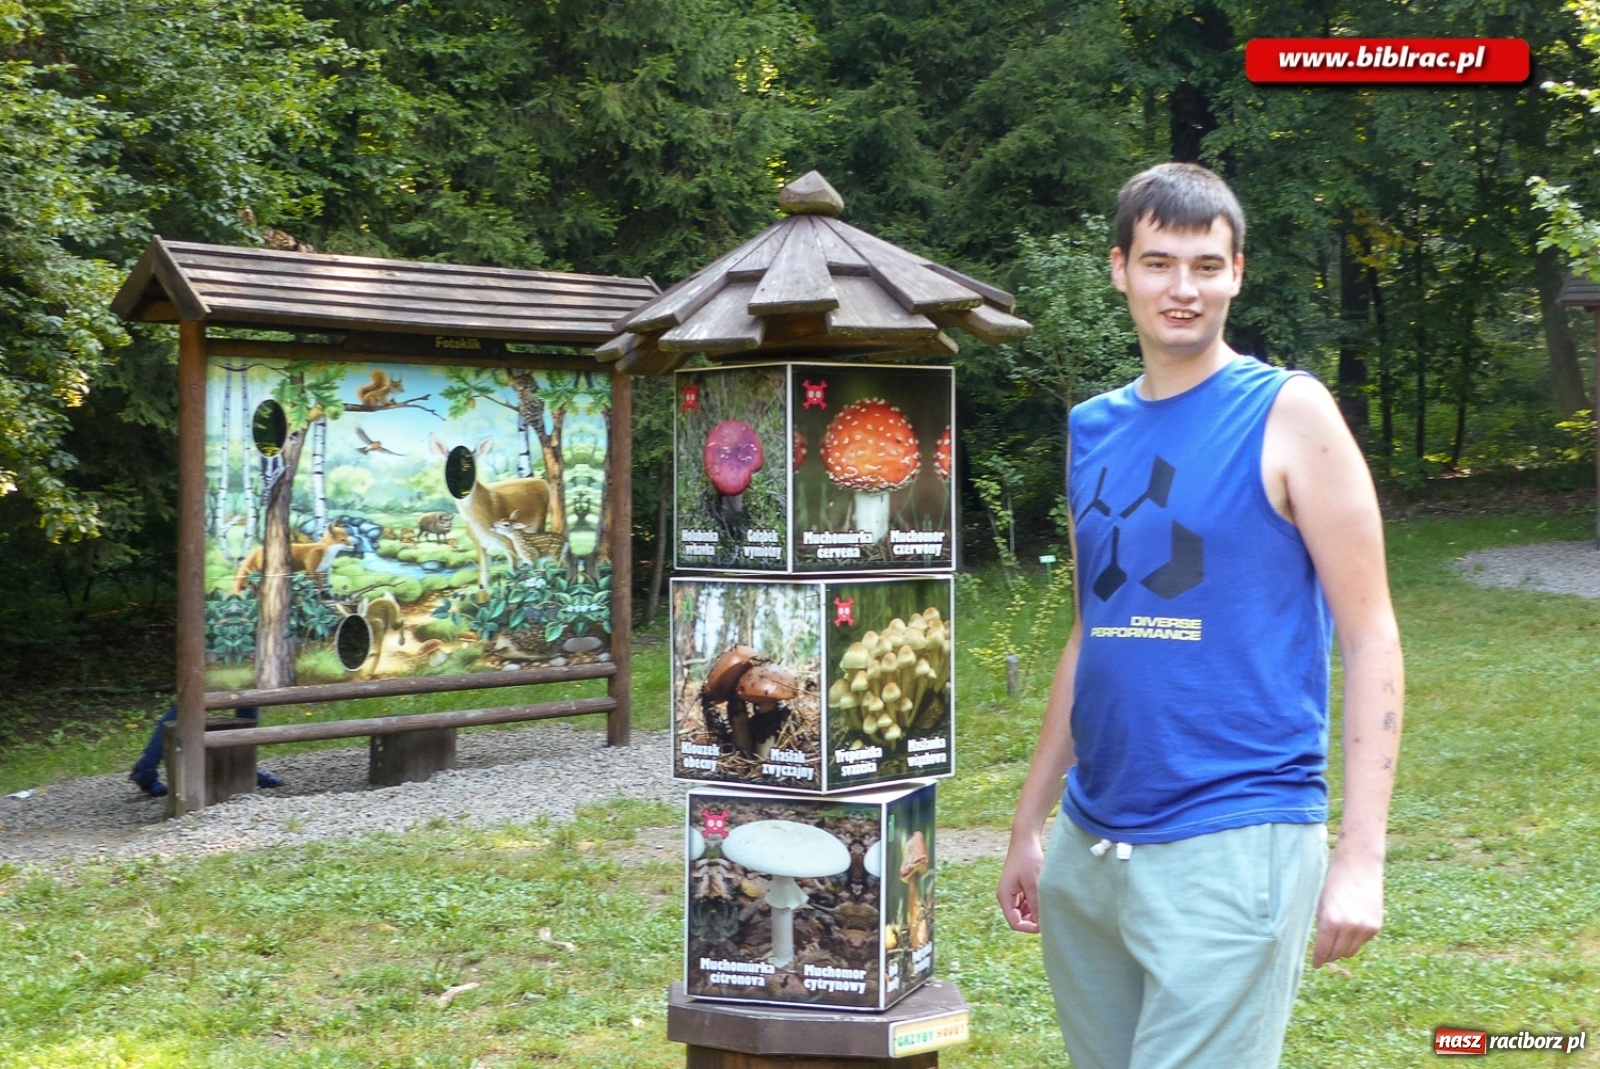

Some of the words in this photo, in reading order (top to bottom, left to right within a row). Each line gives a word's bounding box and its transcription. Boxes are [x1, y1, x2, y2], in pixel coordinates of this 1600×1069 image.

[890, 530, 945, 543] Muchomor
[893, 543, 943, 557] czerwony
[1130, 616, 1202, 629] DIVERSE
[1090, 627, 1201, 640] PERFORMANCE
[762, 764, 814, 780] zwyczajny
[700, 957, 775, 974] Muchomůrka
[804, 964, 867, 980] Muchomor
[804, 978, 867, 994] cytrynowy
[898, 1031, 933, 1047] GRZYBY
